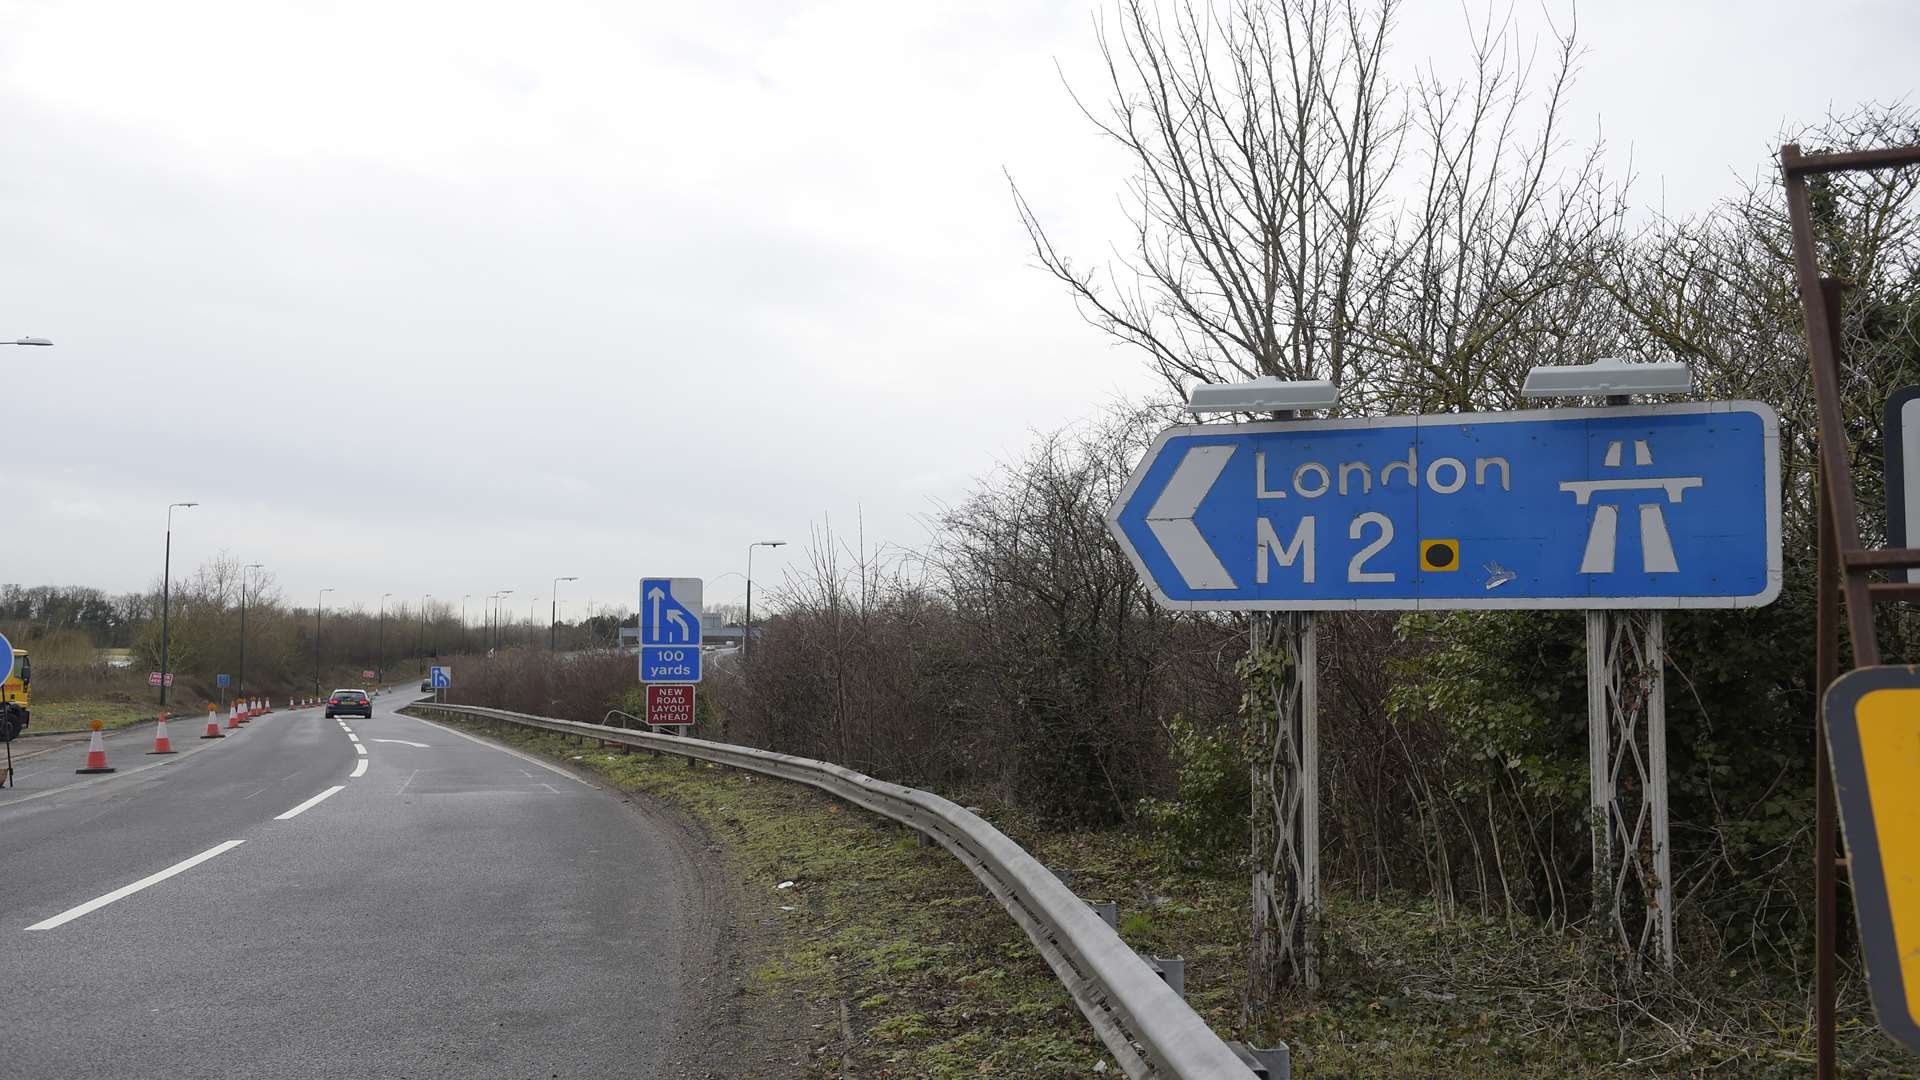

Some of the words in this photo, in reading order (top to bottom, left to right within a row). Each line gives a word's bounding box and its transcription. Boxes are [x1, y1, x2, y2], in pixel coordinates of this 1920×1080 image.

[1256, 447, 1511, 499] London
[657, 650, 685, 662] 100
[650, 664, 691, 677] yards
[659, 688, 683, 696] NEW
[656, 696, 685, 704] ROAD
[651, 705, 690, 713] LAYOUT
[652, 713, 688, 721] AHEAD
